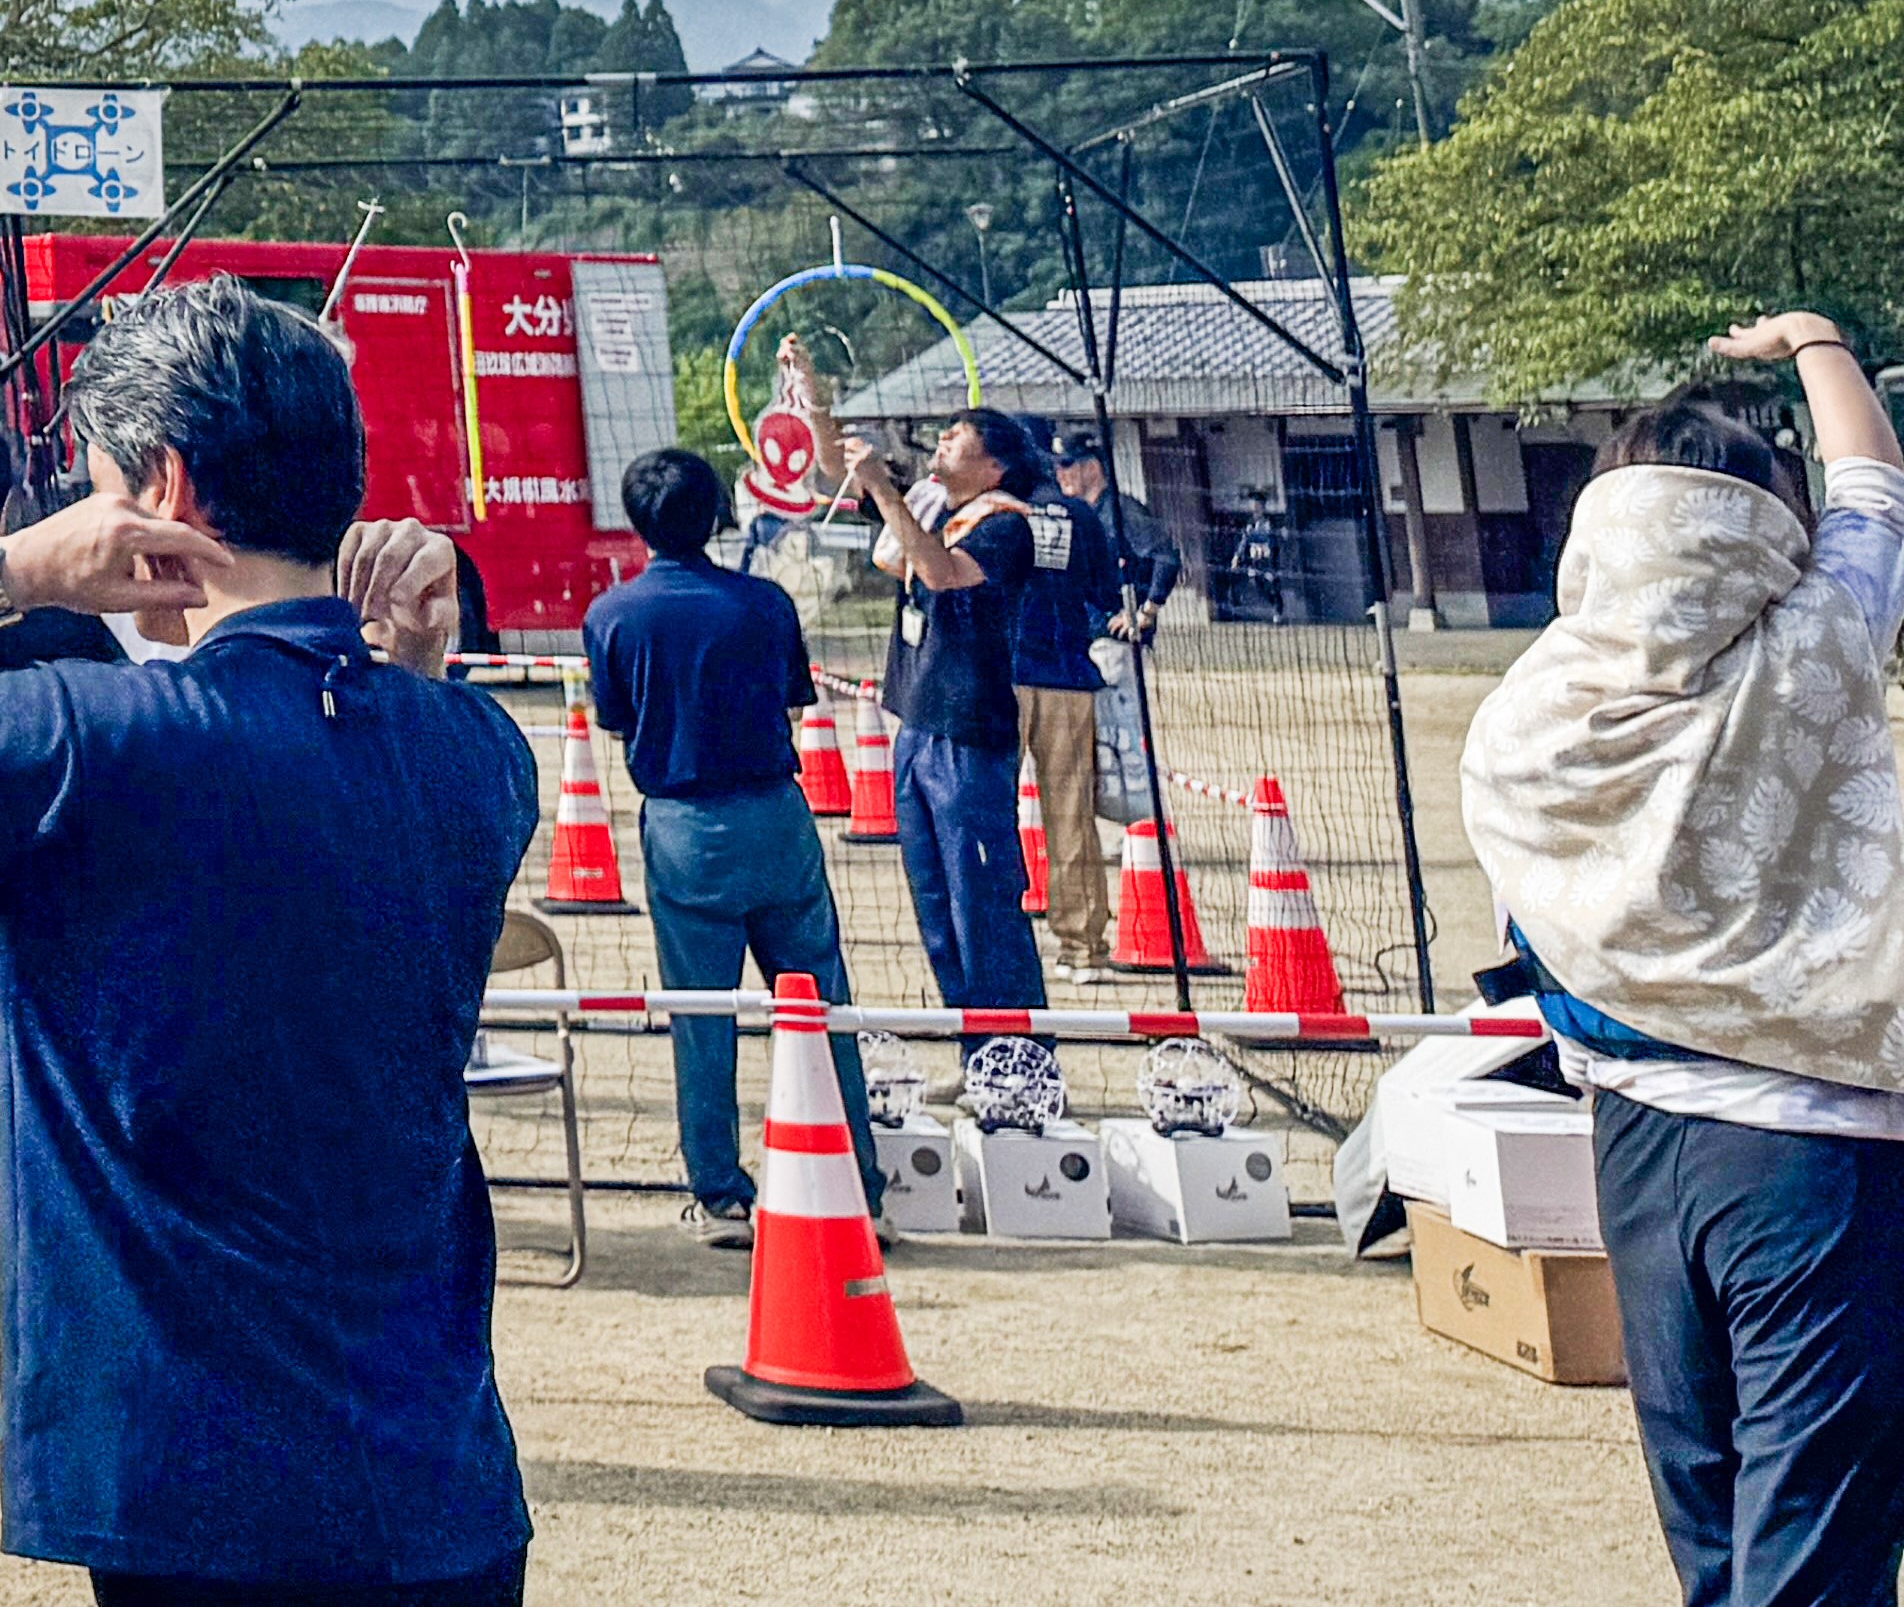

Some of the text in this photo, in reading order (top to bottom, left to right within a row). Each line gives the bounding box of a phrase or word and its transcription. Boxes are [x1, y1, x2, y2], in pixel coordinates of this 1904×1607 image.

[4, 139, 145, 164] トイドローン
